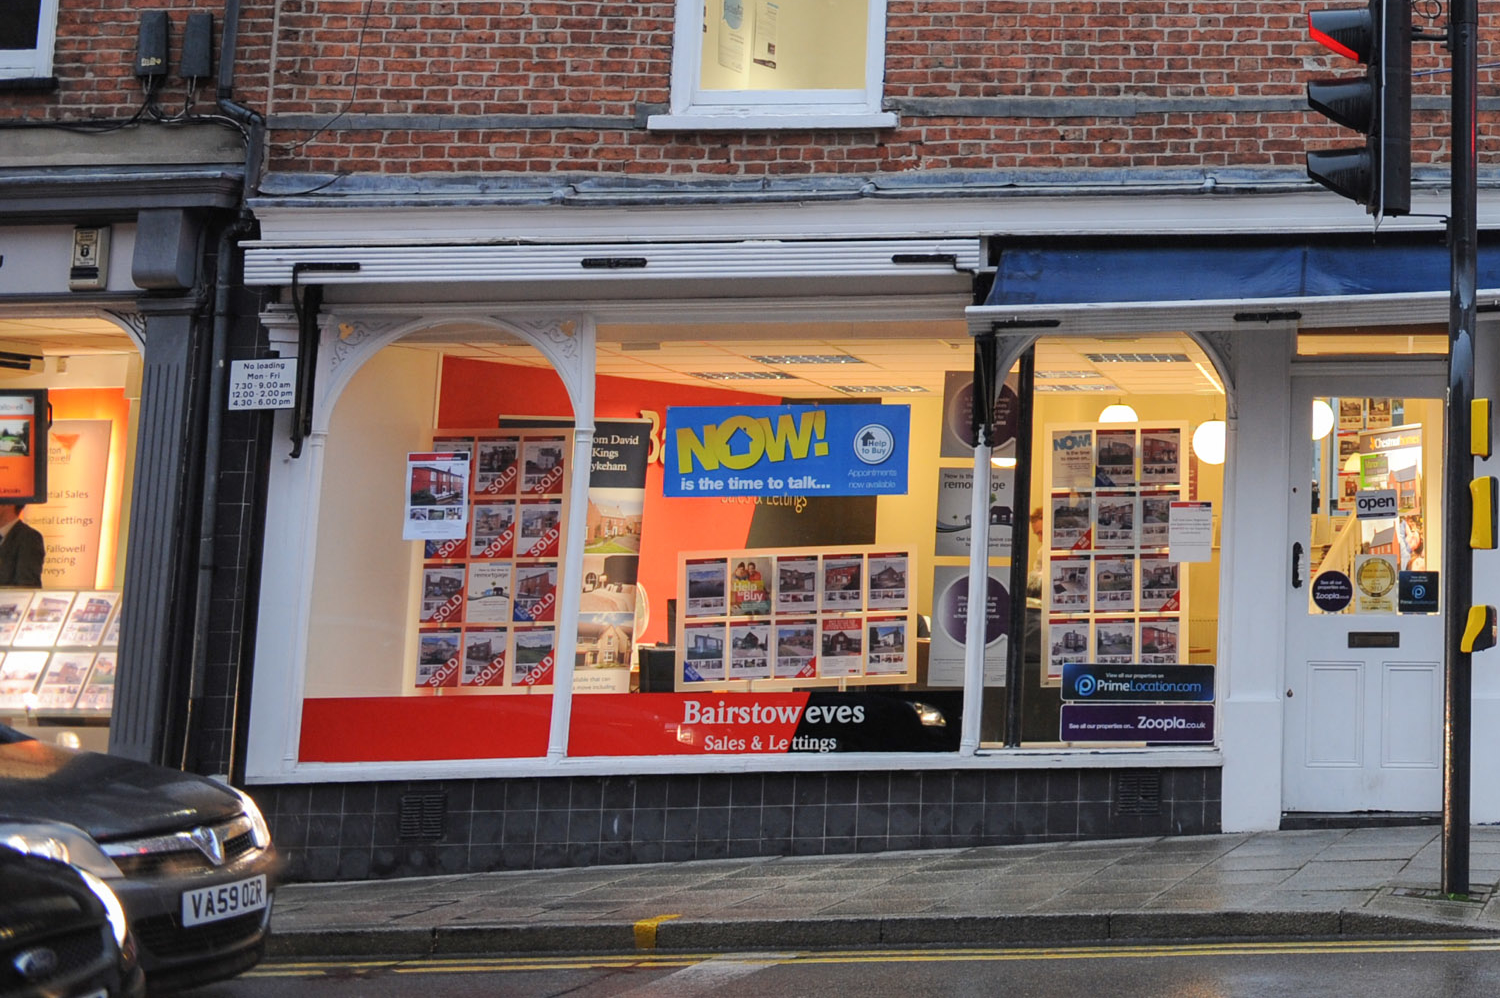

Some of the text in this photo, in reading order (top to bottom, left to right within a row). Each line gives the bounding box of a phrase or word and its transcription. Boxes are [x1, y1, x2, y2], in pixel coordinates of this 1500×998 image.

[257, 362, 285, 370] loading
[235, 382, 253, 390] 7.30
[258, 381, 278, 389] 9.00
[232, 390, 255, 398] 12.00
[260, 390, 279, 398] 2.00
[258, 398, 277, 406] 6.00
[611, 435, 639, 445] David
[676, 410, 829, 474] NOW!
[868, 440, 887, 448] Help
[1053, 433, 1092, 451] NOW!
[592, 448, 619, 459] Kings
[871, 447, 887, 456] Buy
[591, 461, 627, 472] ykeham
[848, 469, 897, 478] Appointments
[487, 466, 517, 495] SOLD
[534, 466, 563, 495] SOLD
[680, 477, 695, 491] is
[698, 477, 724, 490] the
[727, 476, 763, 490] time
[767, 477, 784, 490] to
[866, 480, 896, 489] available
[65, 490, 89, 499] Sales
[1357, 496, 1395, 511] open
[56, 517, 94, 527] Lettings
[46, 544, 86, 553] Fallowell
[437, 538, 464, 558] SOL
[484, 529, 514, 558] SOLD
[530, 528, 559, 557] SOLD
[743, 590, 764, 602] Buy
[433, 594, 463, 623] SOLD
[528, 592, 555, 620] SOLD
[429, 657, 459, 687] SOLD
[474, 657, 504, 687] SOLD
[524, 656, 553, 685] SOLD
[1097, 679, 1202, 692] PrimeLocation.com
[682, 700, 865, 725] Bairstow eves
[1096, 723, 1123, 731] properties
[1137, 716, 1206, 732] Zoopla.co.uk
[704, 735, 746, 751] Sales
[751, 736, 763, 751] &
[192, 879, 262, 919] VA59 OZR
